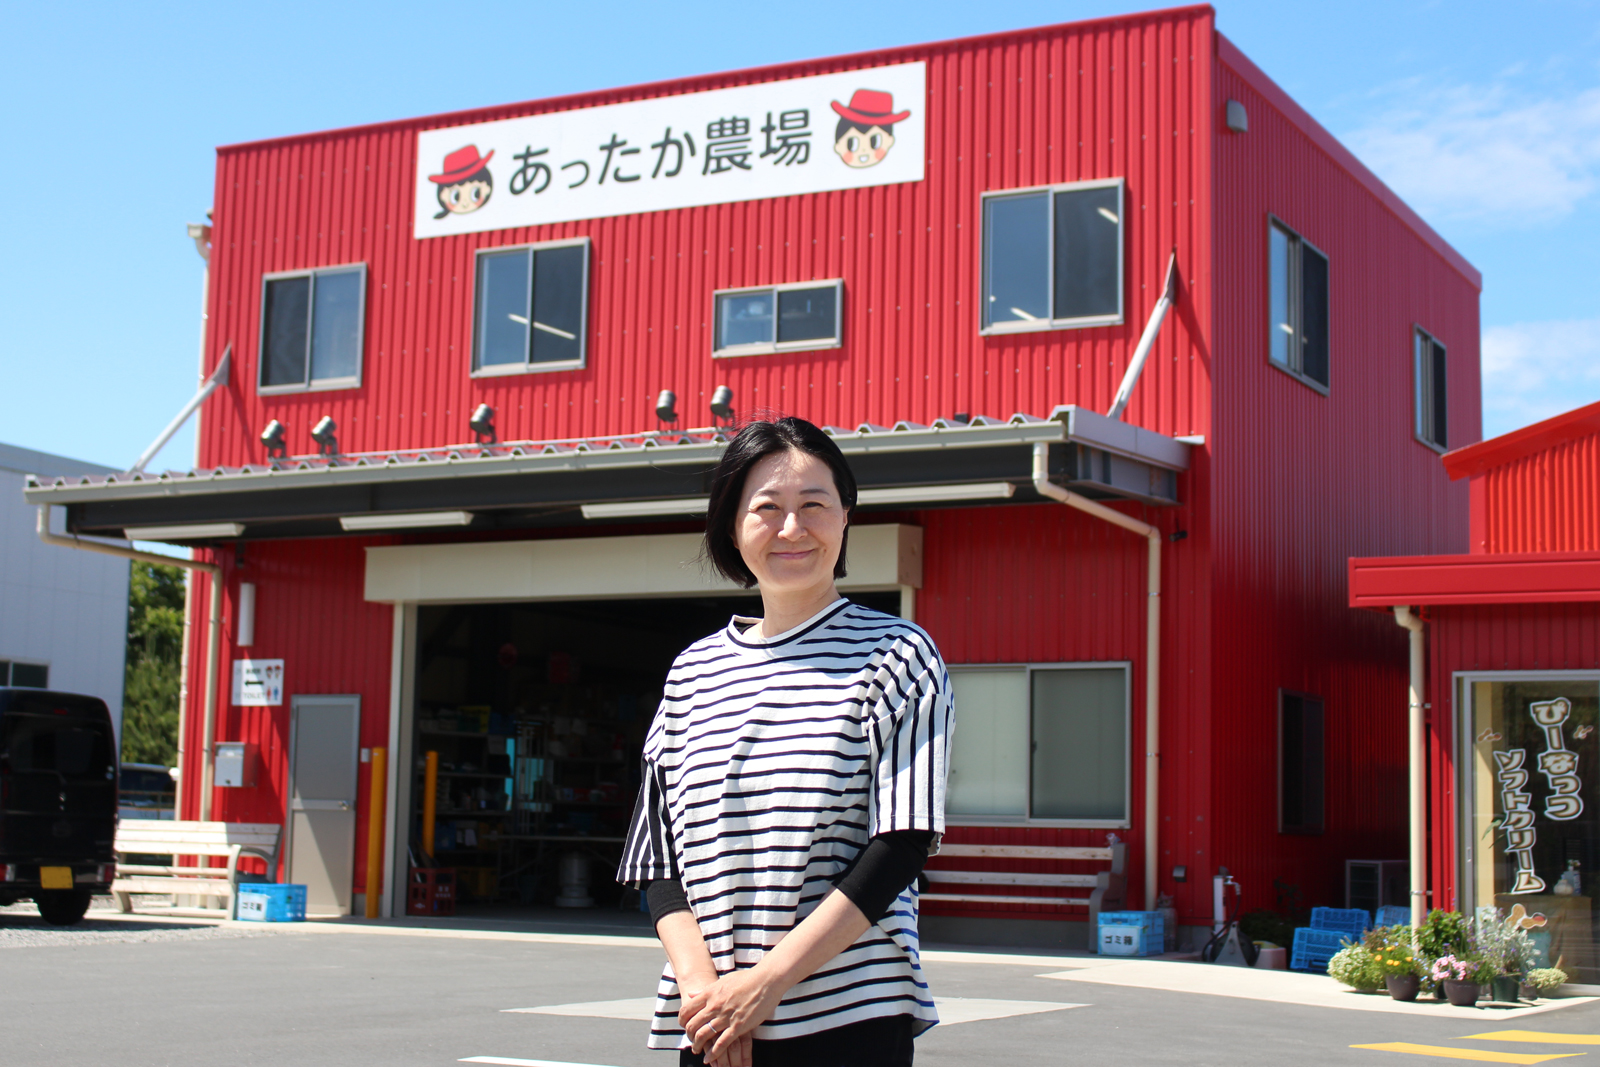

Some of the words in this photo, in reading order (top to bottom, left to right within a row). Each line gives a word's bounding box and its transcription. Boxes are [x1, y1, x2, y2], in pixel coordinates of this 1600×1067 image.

[509, 109, 812, 195] あったか農場
[1531, 699, 1583, 819] ぴーなっつ
[1494, 749, 1545, 893] ソフトクリーム
